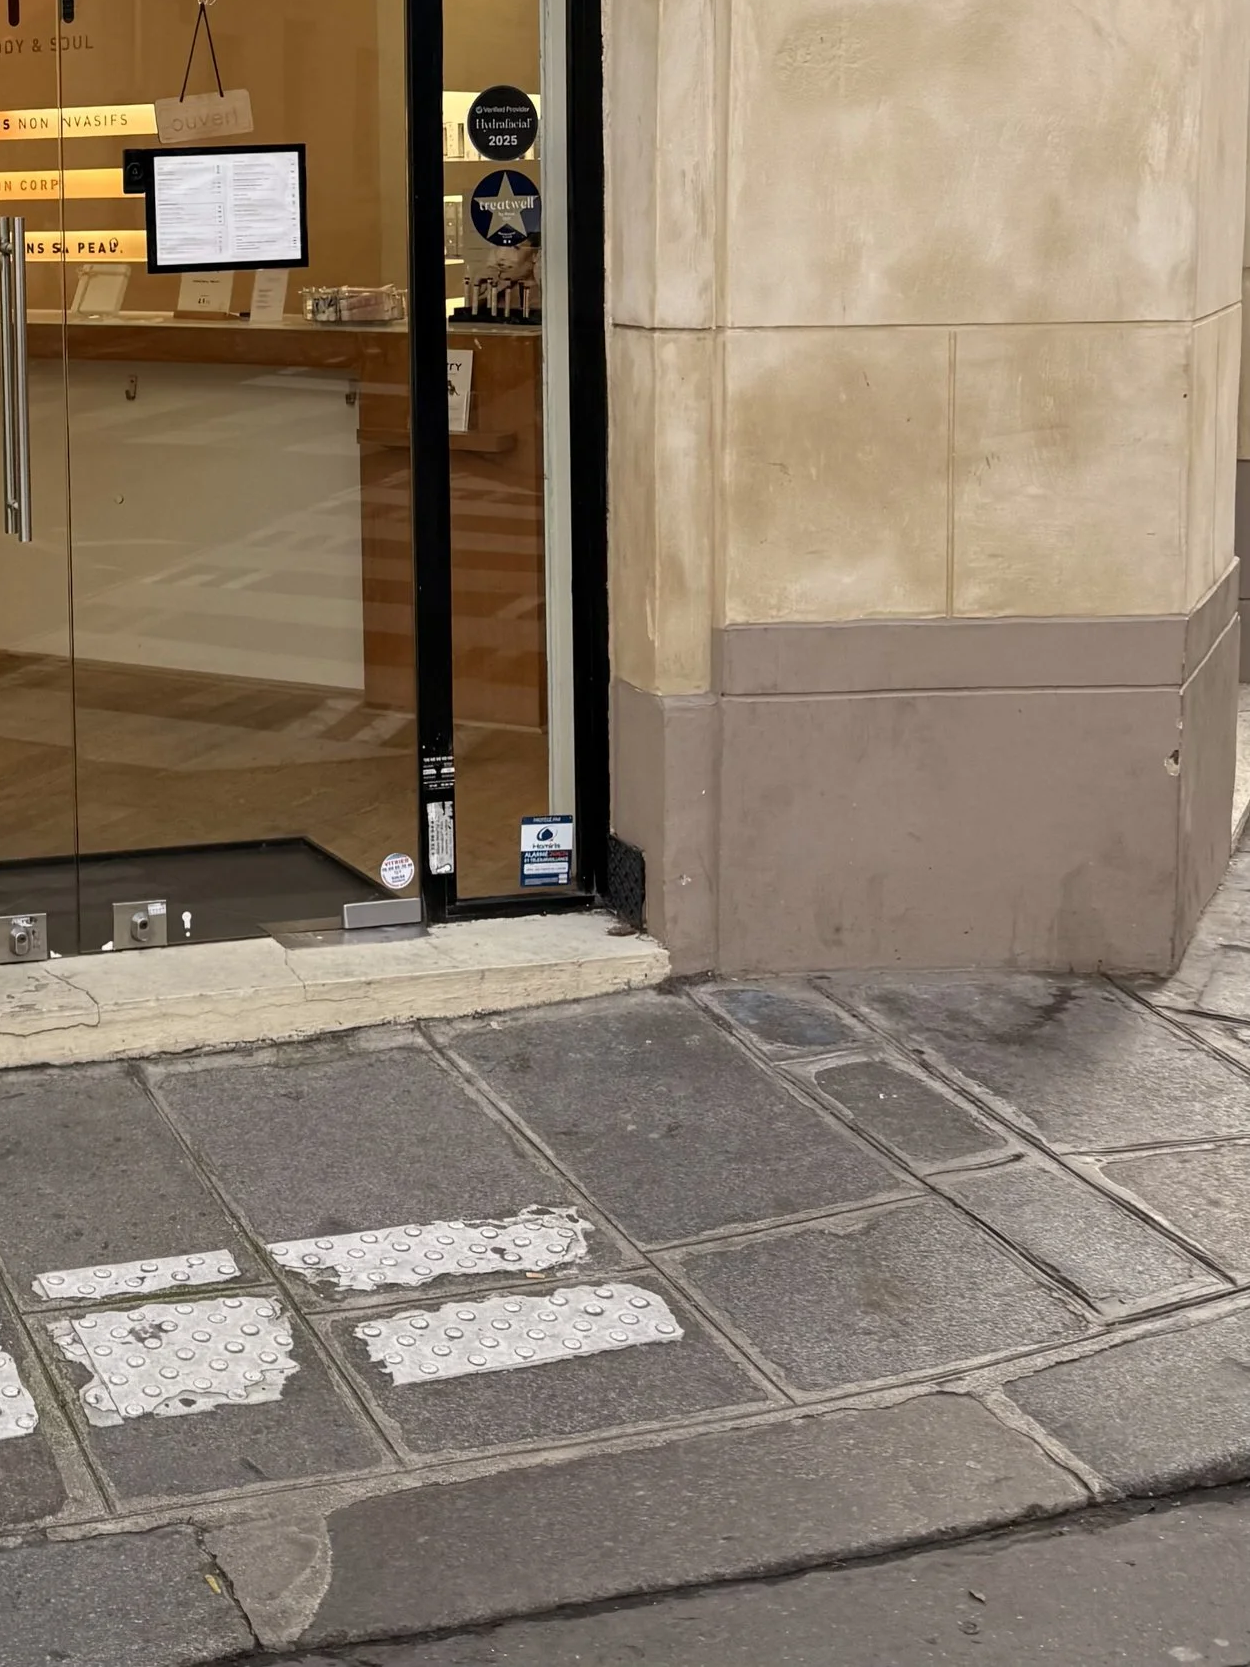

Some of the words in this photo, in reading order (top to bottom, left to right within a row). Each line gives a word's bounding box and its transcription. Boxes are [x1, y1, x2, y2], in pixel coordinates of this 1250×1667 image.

[31, 38, 42, 53] &
[18, 118, 49, 130] NON
[62, 114, 128, 128] NVASIFS
[488, 135, 518, 146] 2025
[20, 179, 59, 191] CORP
[478, 196, 534, 211] treatwell
